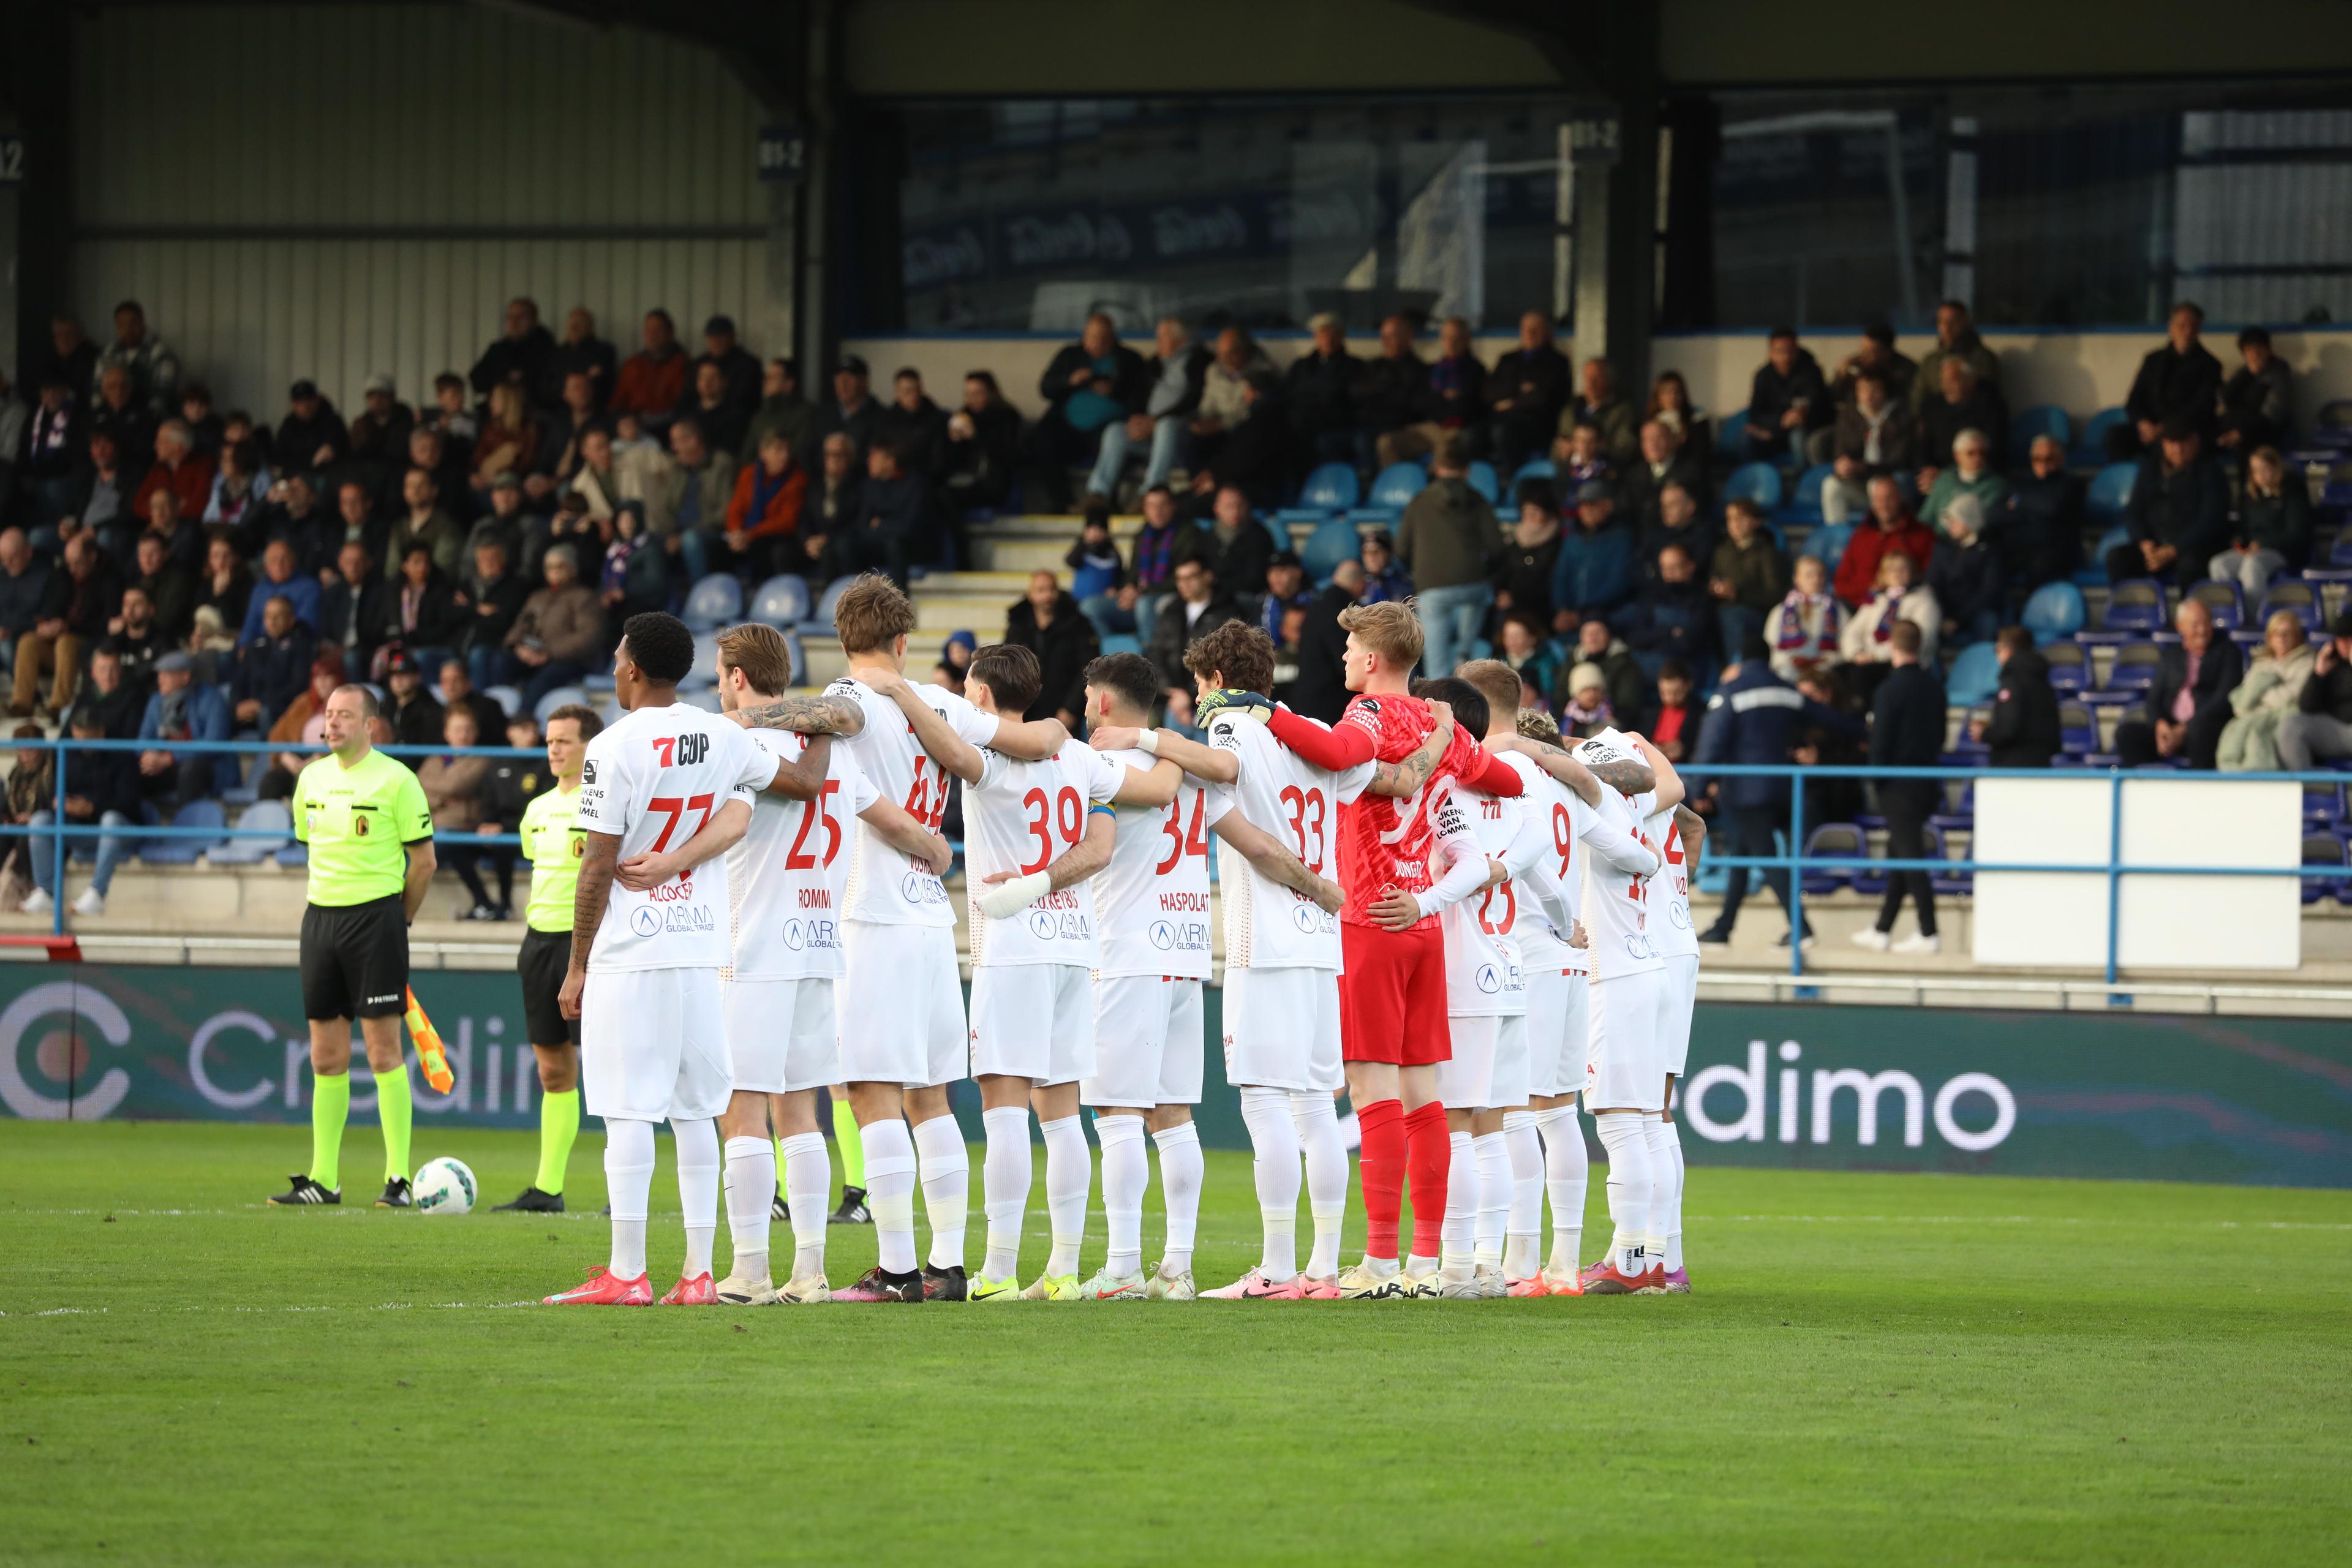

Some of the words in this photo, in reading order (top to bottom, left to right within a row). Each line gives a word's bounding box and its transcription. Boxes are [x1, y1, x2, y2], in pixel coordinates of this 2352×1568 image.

[652, 737, 676, 768] 7
[678, 733, 710, 766] CUP
[785, 779, 842, 871] 25
[1020, 786, 1082, 876] 39
[1156, 788, 1209, 876] 34
[1280, 785, 1325, 875] 33
[1436, 824, 1471, 840] LOMMEL
[1440, 816, 1460, 829] VAN
[647, 792, 715, 883] 77
[1553, 802, 1570, 881] 9
[799, 888, 832, 909] ROMM
[1159, 892, 1208, 912] HASPOLAT
[666, 905, 714, 925] ARMA
[1060, 913, 1090, 933] ARM
[1177, 923, 1211, 943] ARM
[807, 940, 836, 949] GLOBAL
[1504, 983, 1523, 992] GLOBAL
[1674, 1040, 2017, 1152] dimo
